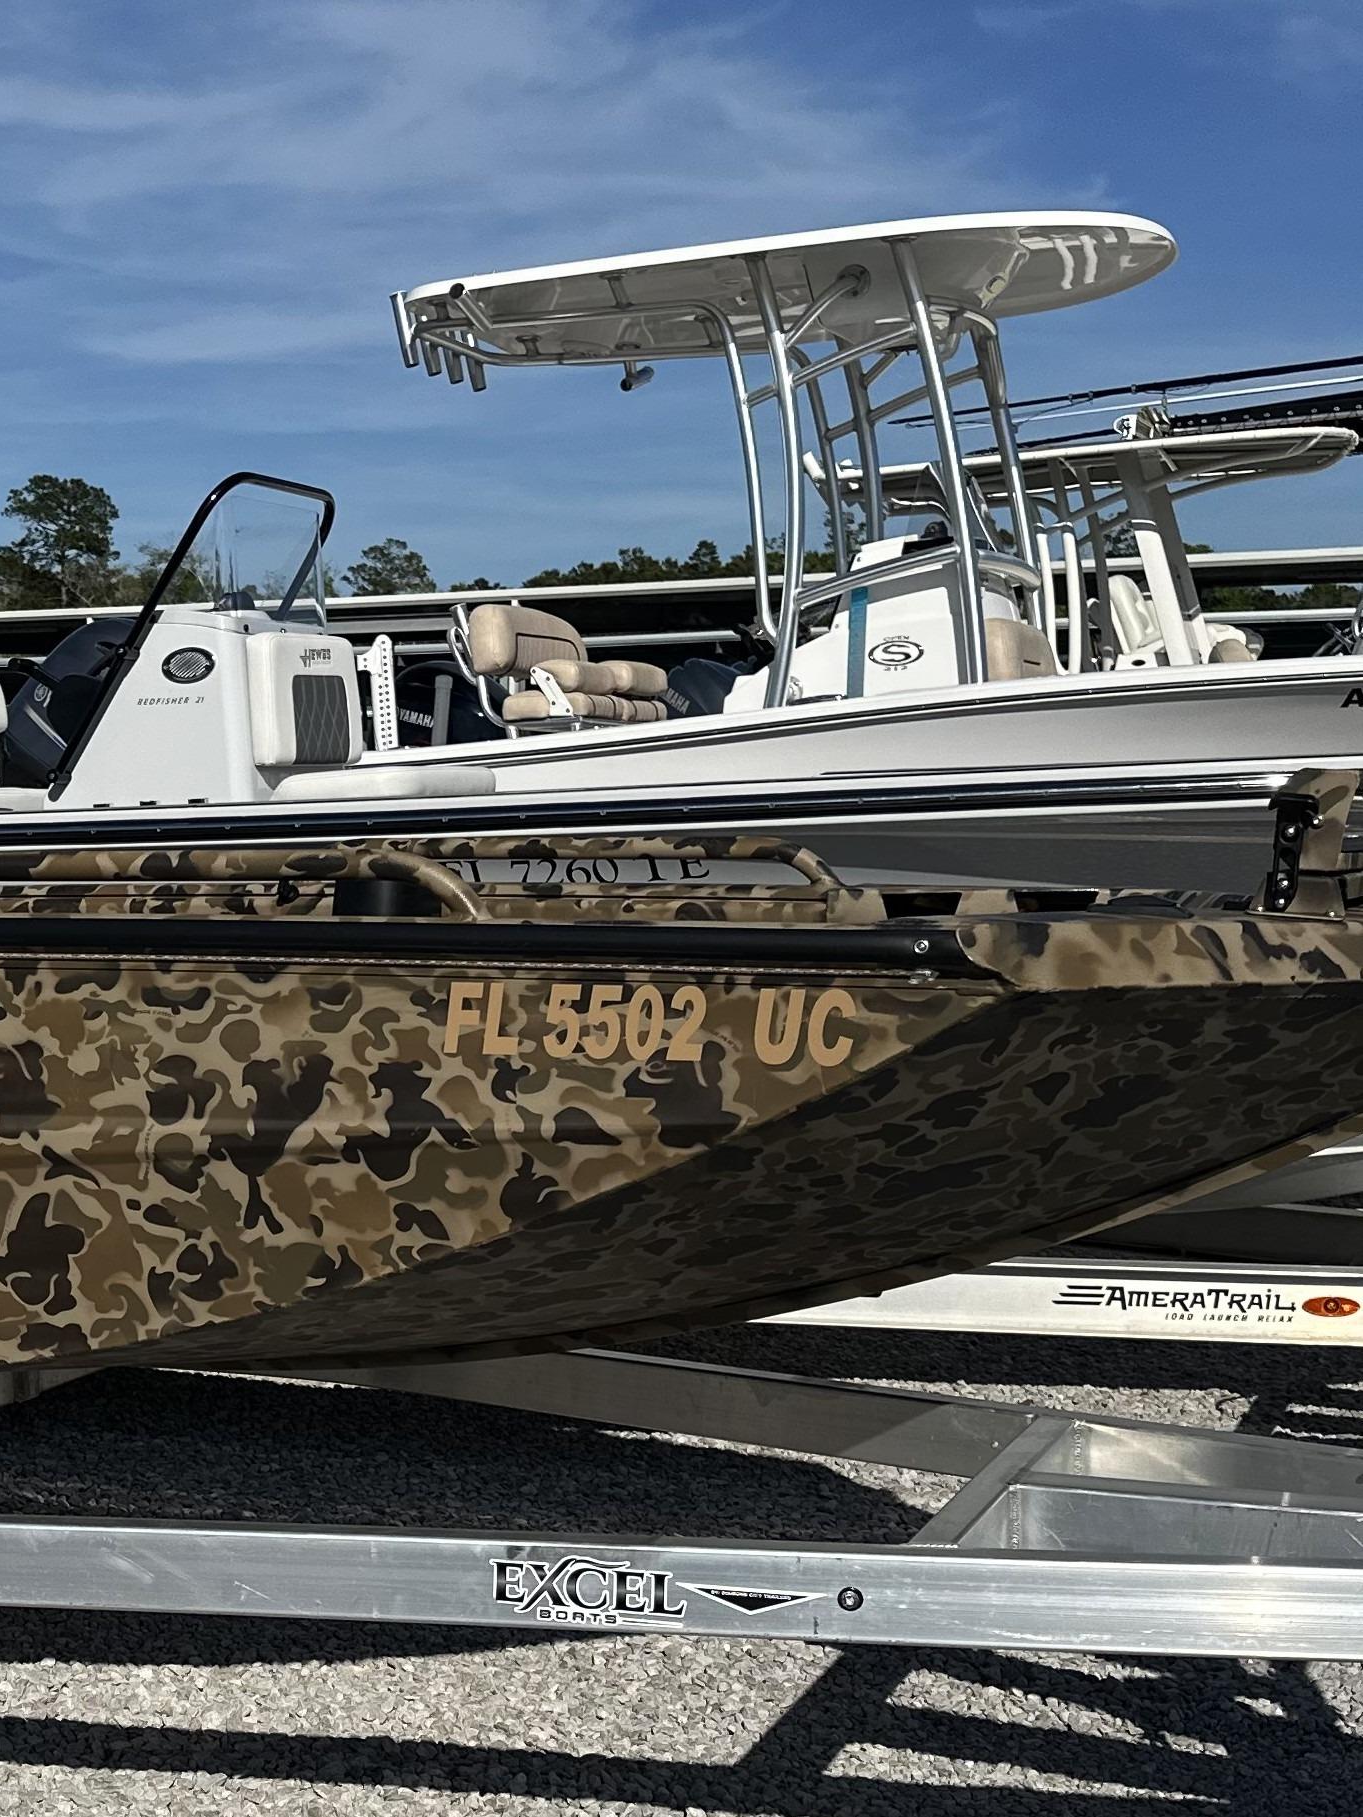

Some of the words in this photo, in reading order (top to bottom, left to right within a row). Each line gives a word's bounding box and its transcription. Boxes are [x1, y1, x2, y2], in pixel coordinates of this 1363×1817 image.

[299, 648, 331, 667] HEWES
[137, 697, 190, 705] REDFISHER
[443, 981, 519, 1055] FL
[543, 984, 707, 1061] 5502
[754, 988, 856, 1067] UC
[490, 1556, 687, 1616] EXCEL
[539, 1609, 617, 1624] BOATS
